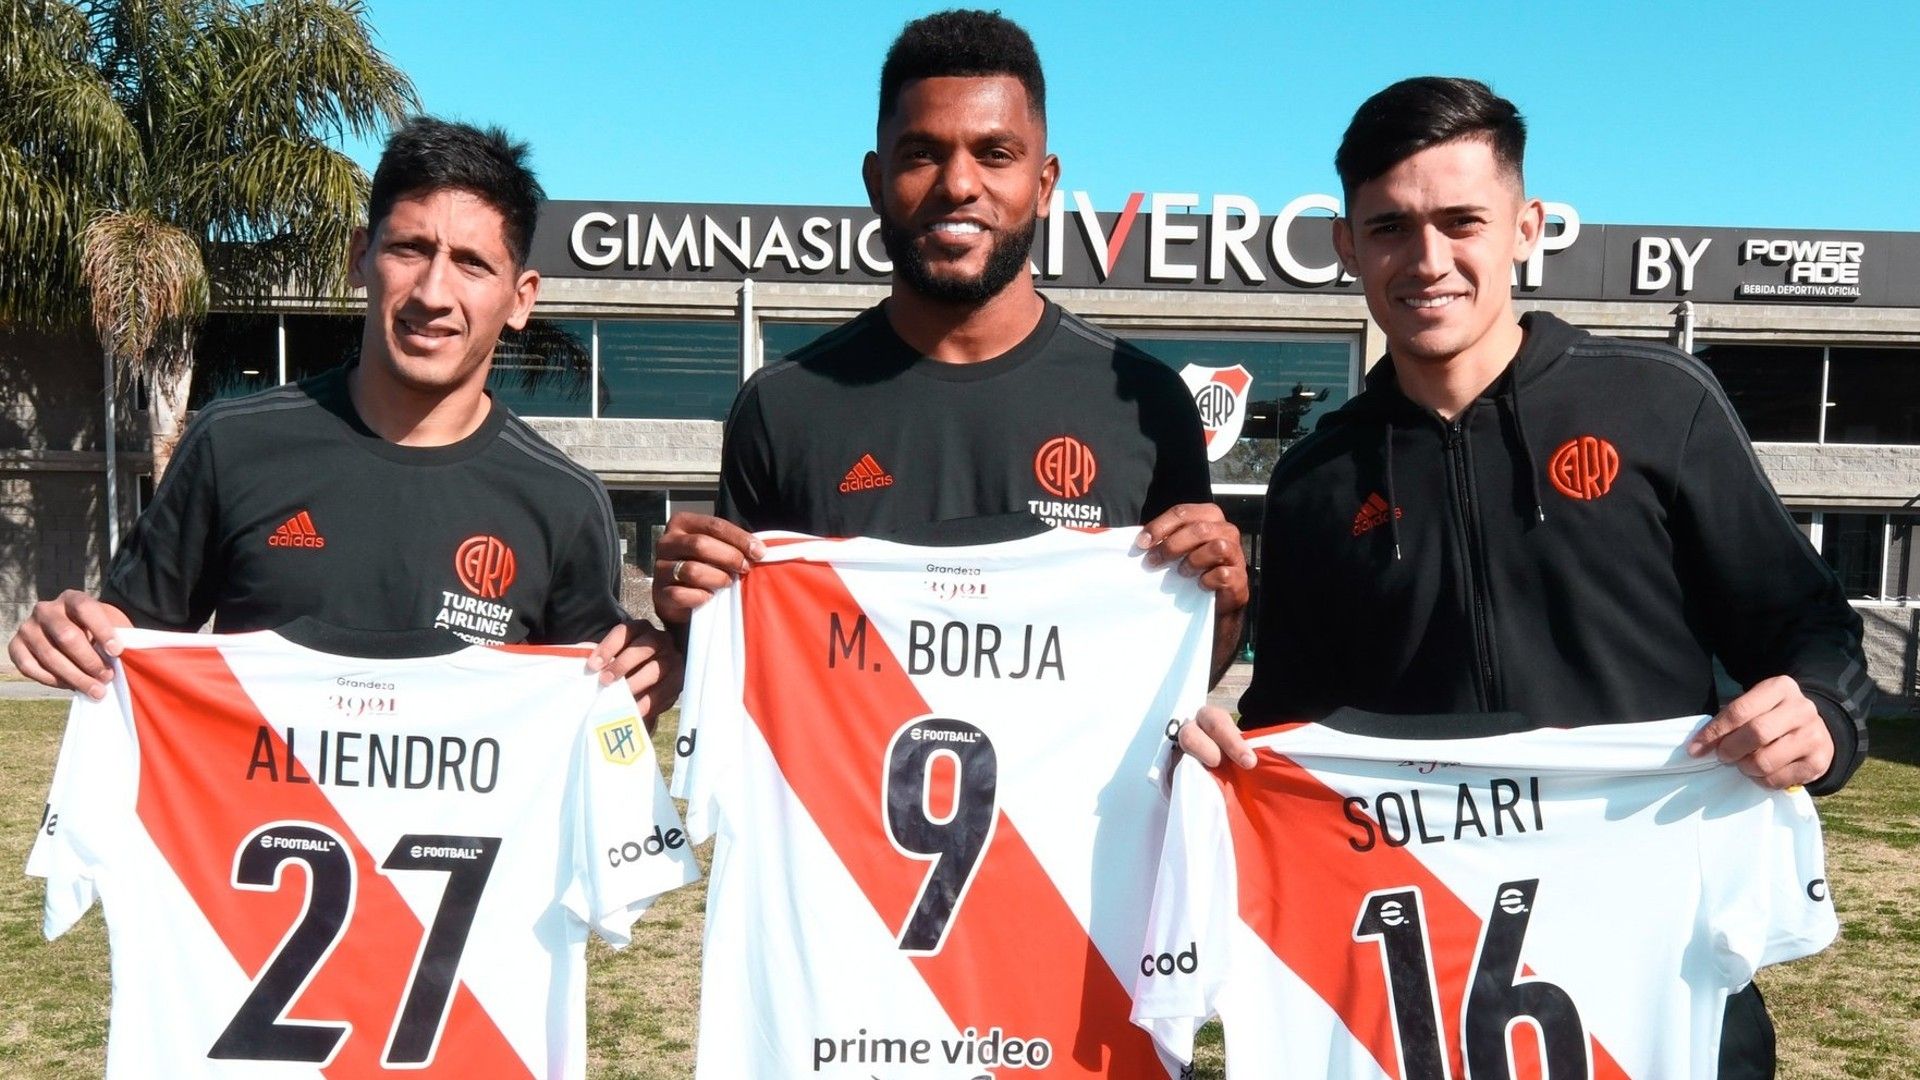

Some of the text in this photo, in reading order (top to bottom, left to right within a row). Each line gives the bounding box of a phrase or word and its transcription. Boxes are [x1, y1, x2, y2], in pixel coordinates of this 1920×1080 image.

[1637, 236, 1712, 291] BY
[1746, 239, 1865, 263] POWER
[1792, 261, 1860, 284] ADE
[1743, 284, 1861, 296] BEBIDA DEPORTIVA OFICIAL
[839, 473, 894, 494] adidas
[1028, 500, 1102, 521] TURKISH
[267, 533, 325, 548] adidas
[926, 563, 981, 575] Grandeza
[442, 591, 513, 622] TURKISH
[435, 607, 508, 637] AIRLINES
[828, 612, 1066, 681] M. BORJA
[336, 677, 395, 690] Grandeza
[246, 726, 500, 794] ALIENDRO
[1342, 776, 1545, 852] SOLARI
[882, 717, 998, 951] 9
[207, 825, 502, 1063] 27
[1355, 878, 1588, 1080] 16
[813, 1028, 1050, 1071] prime video
